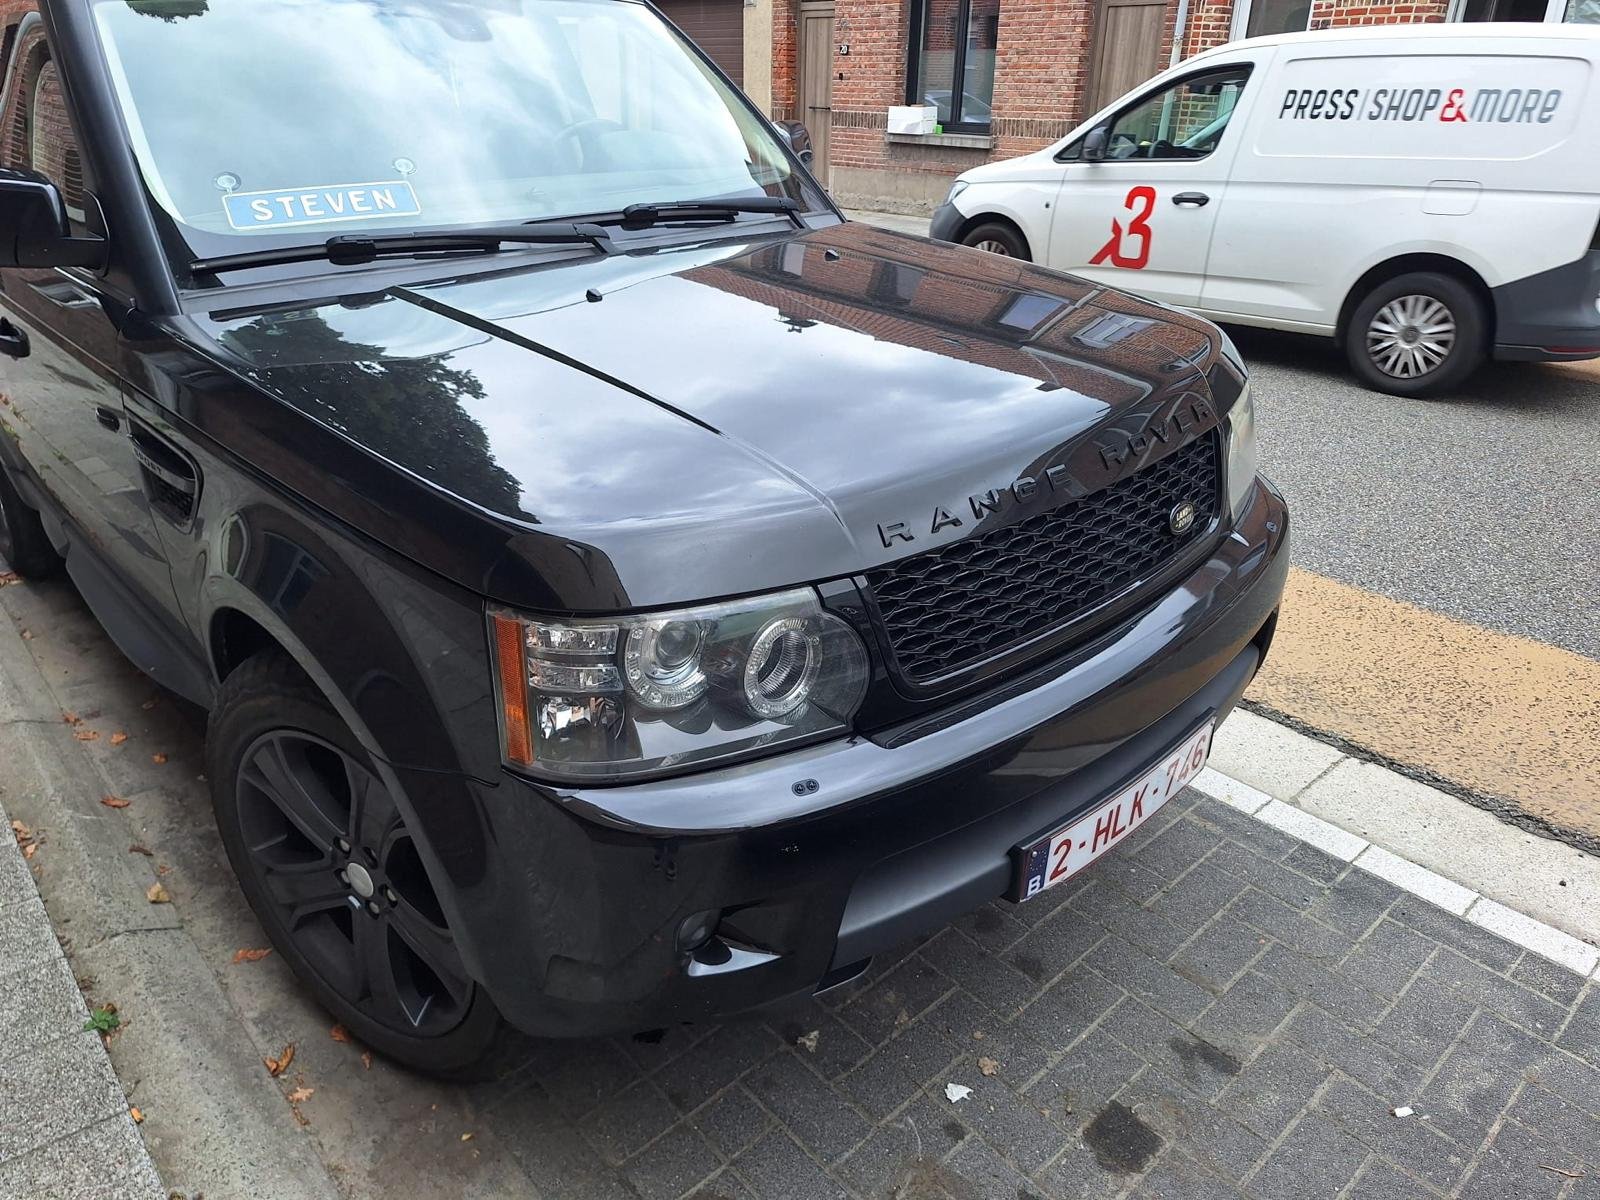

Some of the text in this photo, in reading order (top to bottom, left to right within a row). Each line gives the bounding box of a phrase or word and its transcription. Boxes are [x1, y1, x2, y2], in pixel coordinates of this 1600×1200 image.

[1368, 89, 1441, 121] SHOP
[251, 188, 396, 221] STEVEN
[877, 400, 1209, 548] RANGE ROVER
[1026, 875, 1041, 897] B
